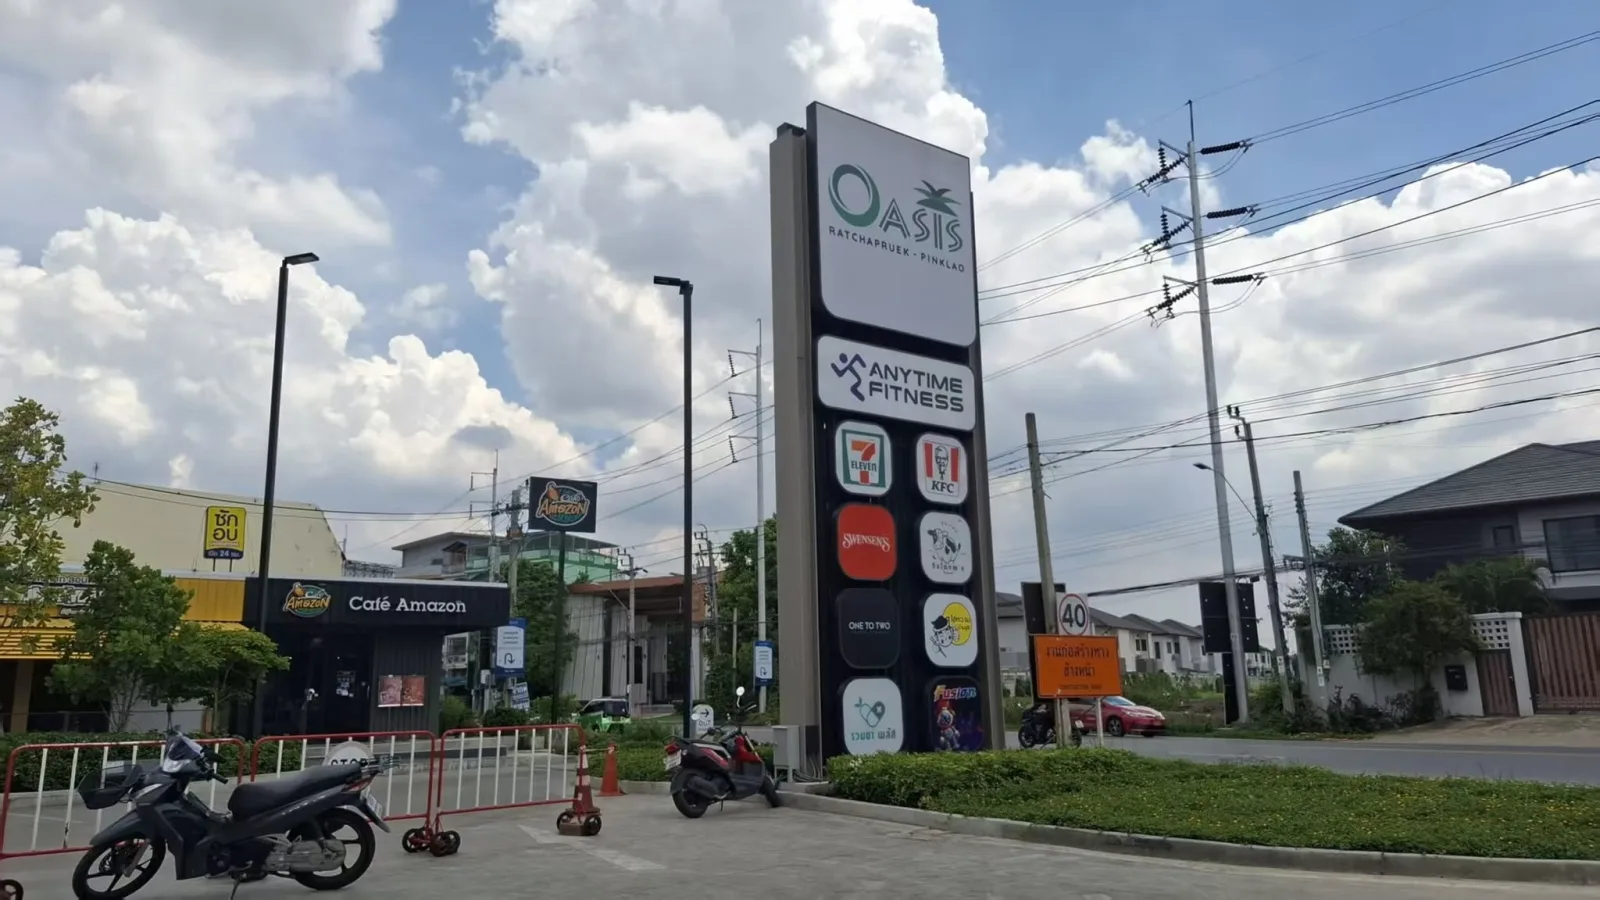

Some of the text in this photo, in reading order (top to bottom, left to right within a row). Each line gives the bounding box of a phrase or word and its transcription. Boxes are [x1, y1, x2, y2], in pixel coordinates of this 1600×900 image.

[828, 164, 963, 252] OASIS
[829, 226, 909, 257] RATCHAPRUEK
[920, 252, 965, 273] PINKLAO
[869, 362, 963, 394] ANYTIME
[869, 381, 964, 413] FITNESS
[931, 480, 955, 494] KFC
[212, 528, 238, 541] อบ
[349, 596, 467, 613] Café Amazon
[1062, 603, 1086, 628] 40
[848, 621, 891, 630] ONE TO TWO
